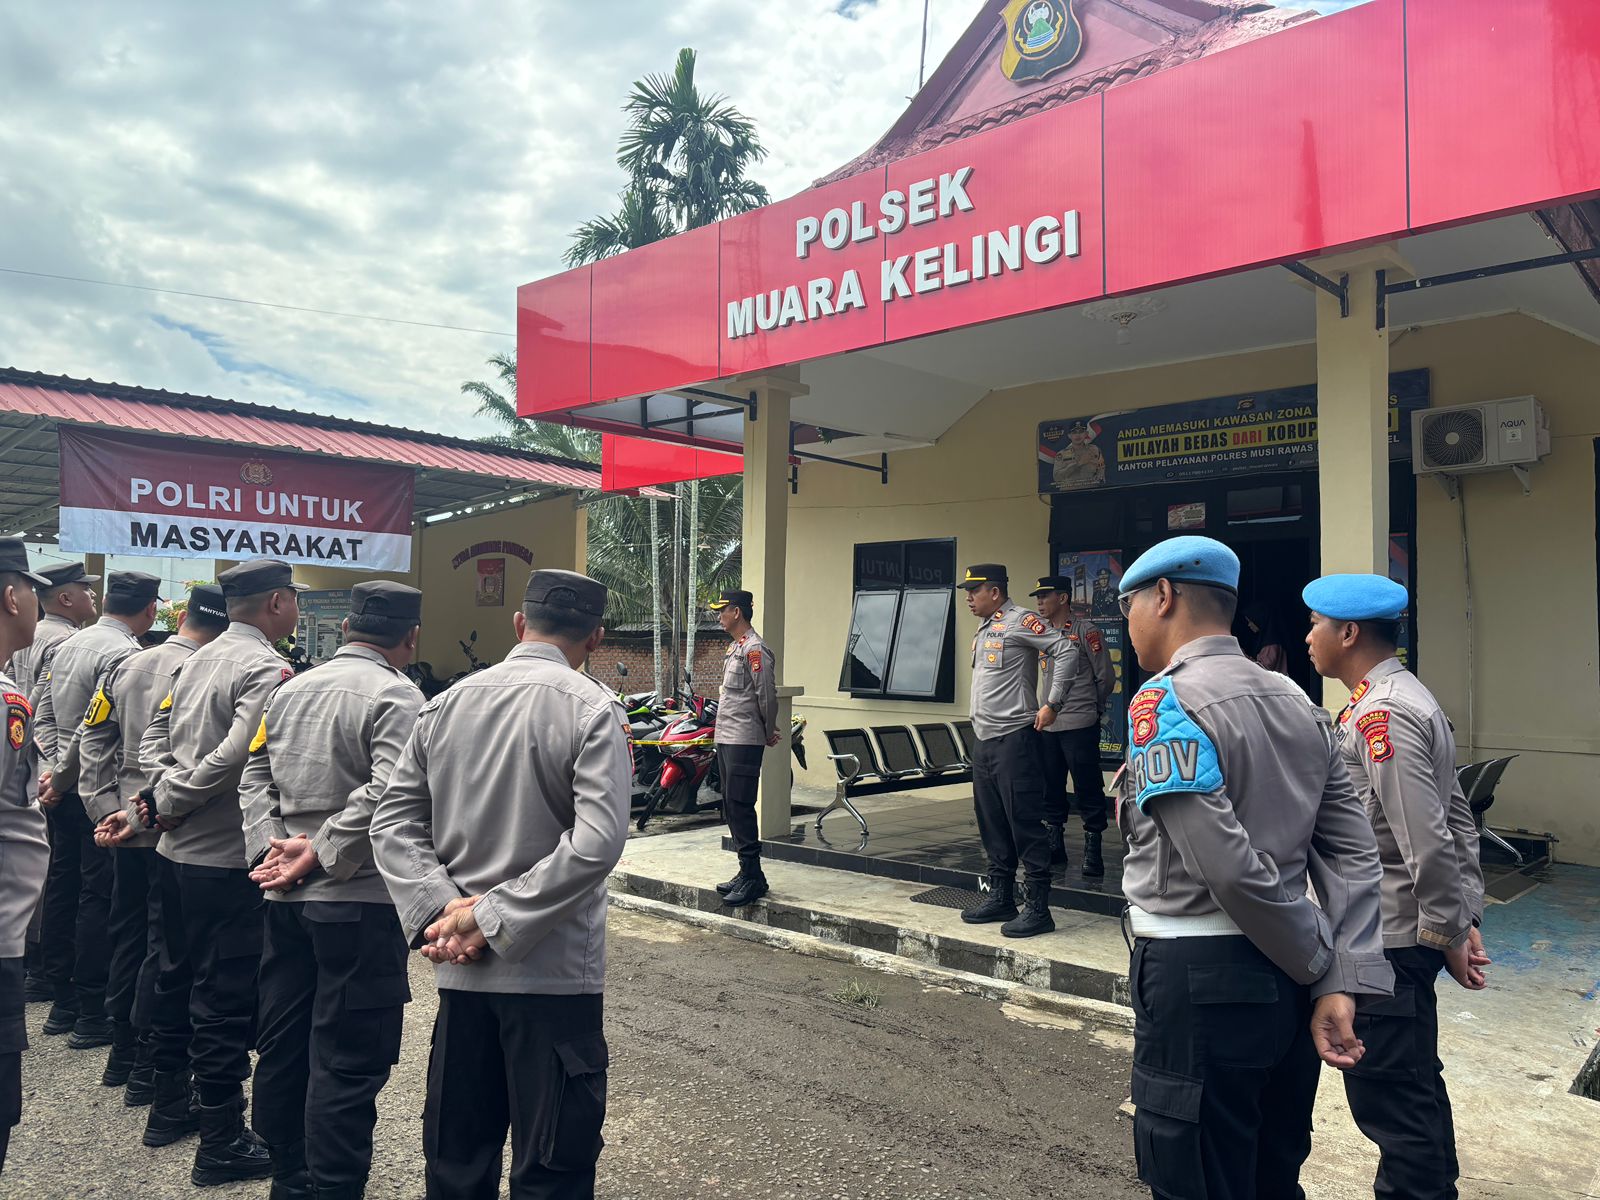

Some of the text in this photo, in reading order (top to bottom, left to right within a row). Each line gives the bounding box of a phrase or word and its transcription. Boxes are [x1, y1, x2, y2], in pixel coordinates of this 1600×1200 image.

[796, 166, 975, 259] POLSEK
[727, 209, 1079, 339] MUARA KELINGI
[1117, 405, 1312, 440] ANDA MEMASUKI KAWASAN ZONA
[1122, 421, 1317, 458] WILAYAH BEBAS DARI KORUP
[1500, 419, 1526, 428] AQUA
[1117, 443, 1313, 471] KANTOR PELAYANAN POLRES MUSI RAWAS
[130, 477, 364, 525] POLRI UNTUK
[130, 521, 363, 561] MASYARAKAT
[1135, 739, 1199, 794] ROV
